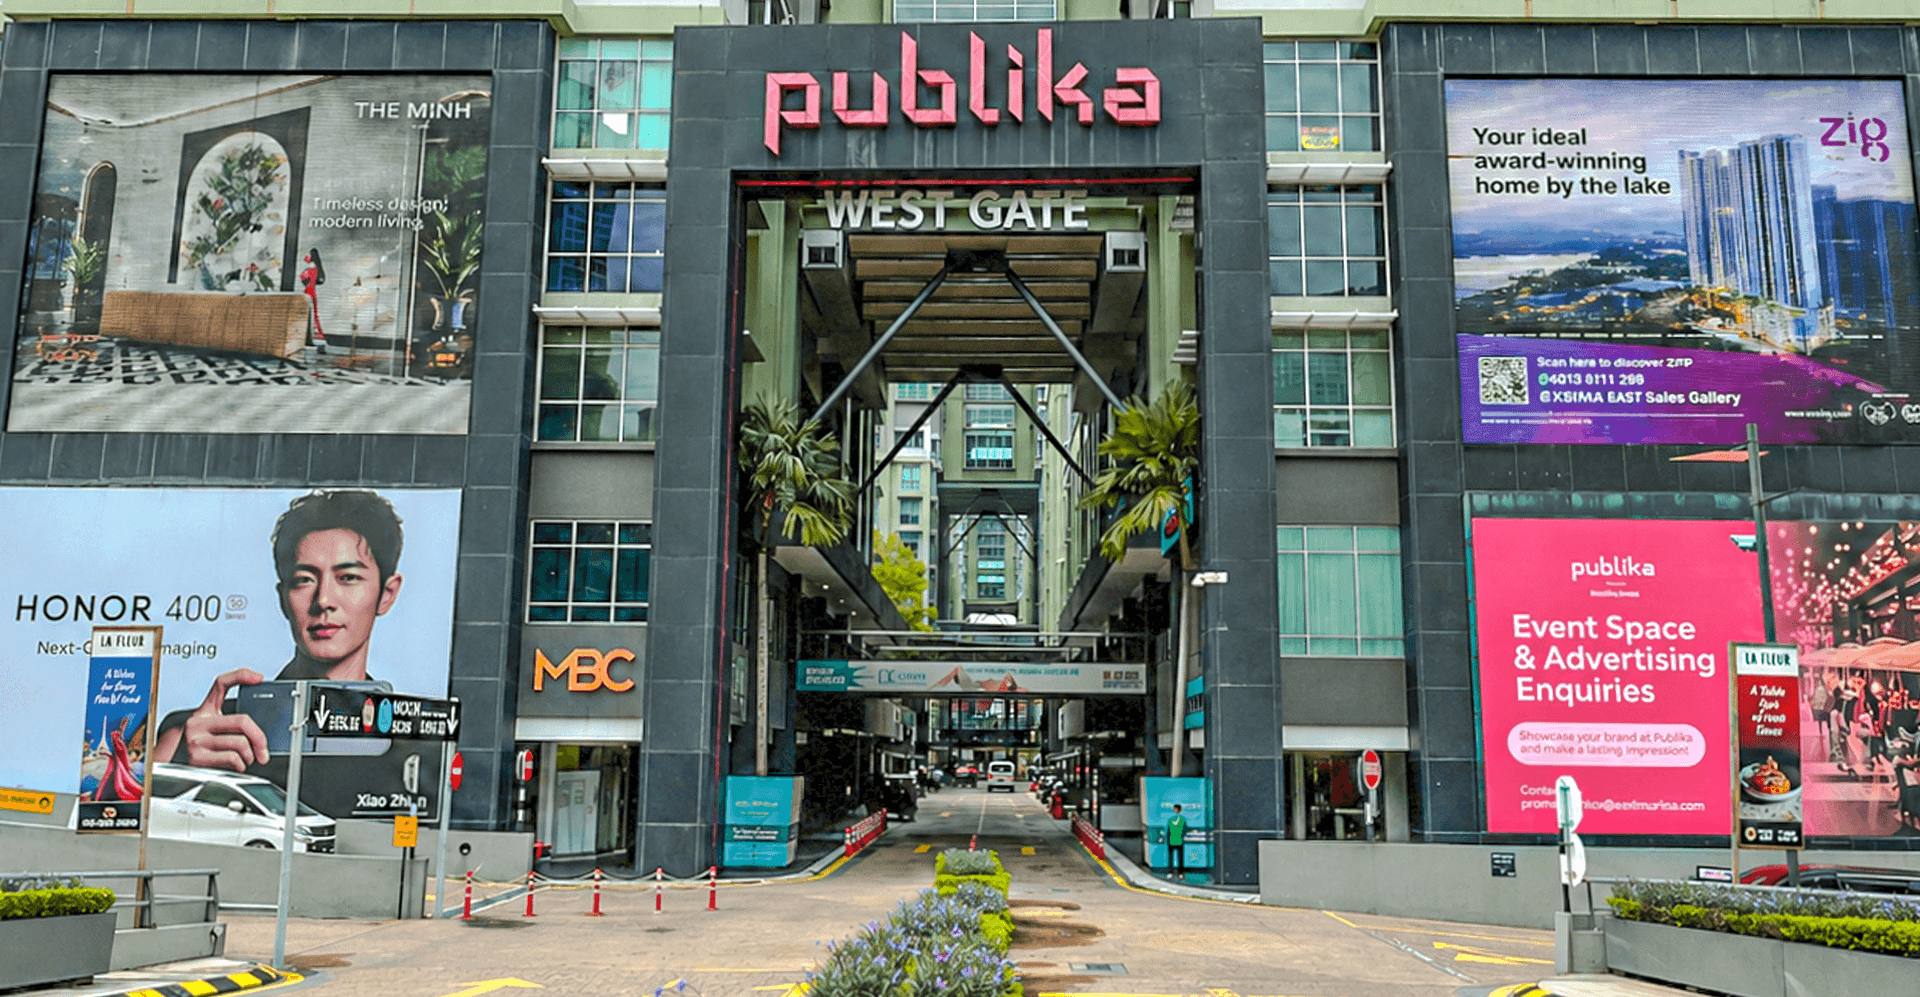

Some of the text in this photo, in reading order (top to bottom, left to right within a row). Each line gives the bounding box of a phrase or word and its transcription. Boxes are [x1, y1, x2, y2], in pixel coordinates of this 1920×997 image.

[764, 28, 1161, 156] publika
[354, 102, 471, 119] THE MINH
[1473, 127, 1587, 146] Your ideal
[1474, 151, 1647, 174] award-winning
[1475, 177, 1671, 199] home by the lake
[313, 197, 383, 211] Timeless
[825, 190, 1089, 230] WEST GATE
[308, 215, 373, 228] modern
[1537, 356, 1567, 367] Scan
[1598, 357, 1612, 368] to
[1645, 390, 1686, 405] Sales
[1688, 390, 1742, 408] Gallery
[1571, 555, 1656, 582] publika
[16, 594, 152, 622] HONOR
[165, 594, 222, 622] 400
[1512, 613, 1696, 646] Event Space
[100, 634, 145, 648] LA FLEUR
[161, 641, 217, 659] maging
[1513, 644, 1716, 678] & Advertising
[1745, 652, 1791, 666] LA FLEUR
[533, 647, 636, 692] MBC
[1516, 676, 1656, 708] Enquiries
[1519, 730, 1575, 741] Showcase
[1577, 733, 1601, 744] your
[1604, 731, 1637, 742] brand
[1653, 732, 1694, 743] Publika
[1520, 743, 1541, 754] and
[1543, 744, 1575, 755] make
[1577, 746, 1584, 754] a
[1586, 743, 1623, 757] lasting
[356, 793, 387, 808] Xiao
